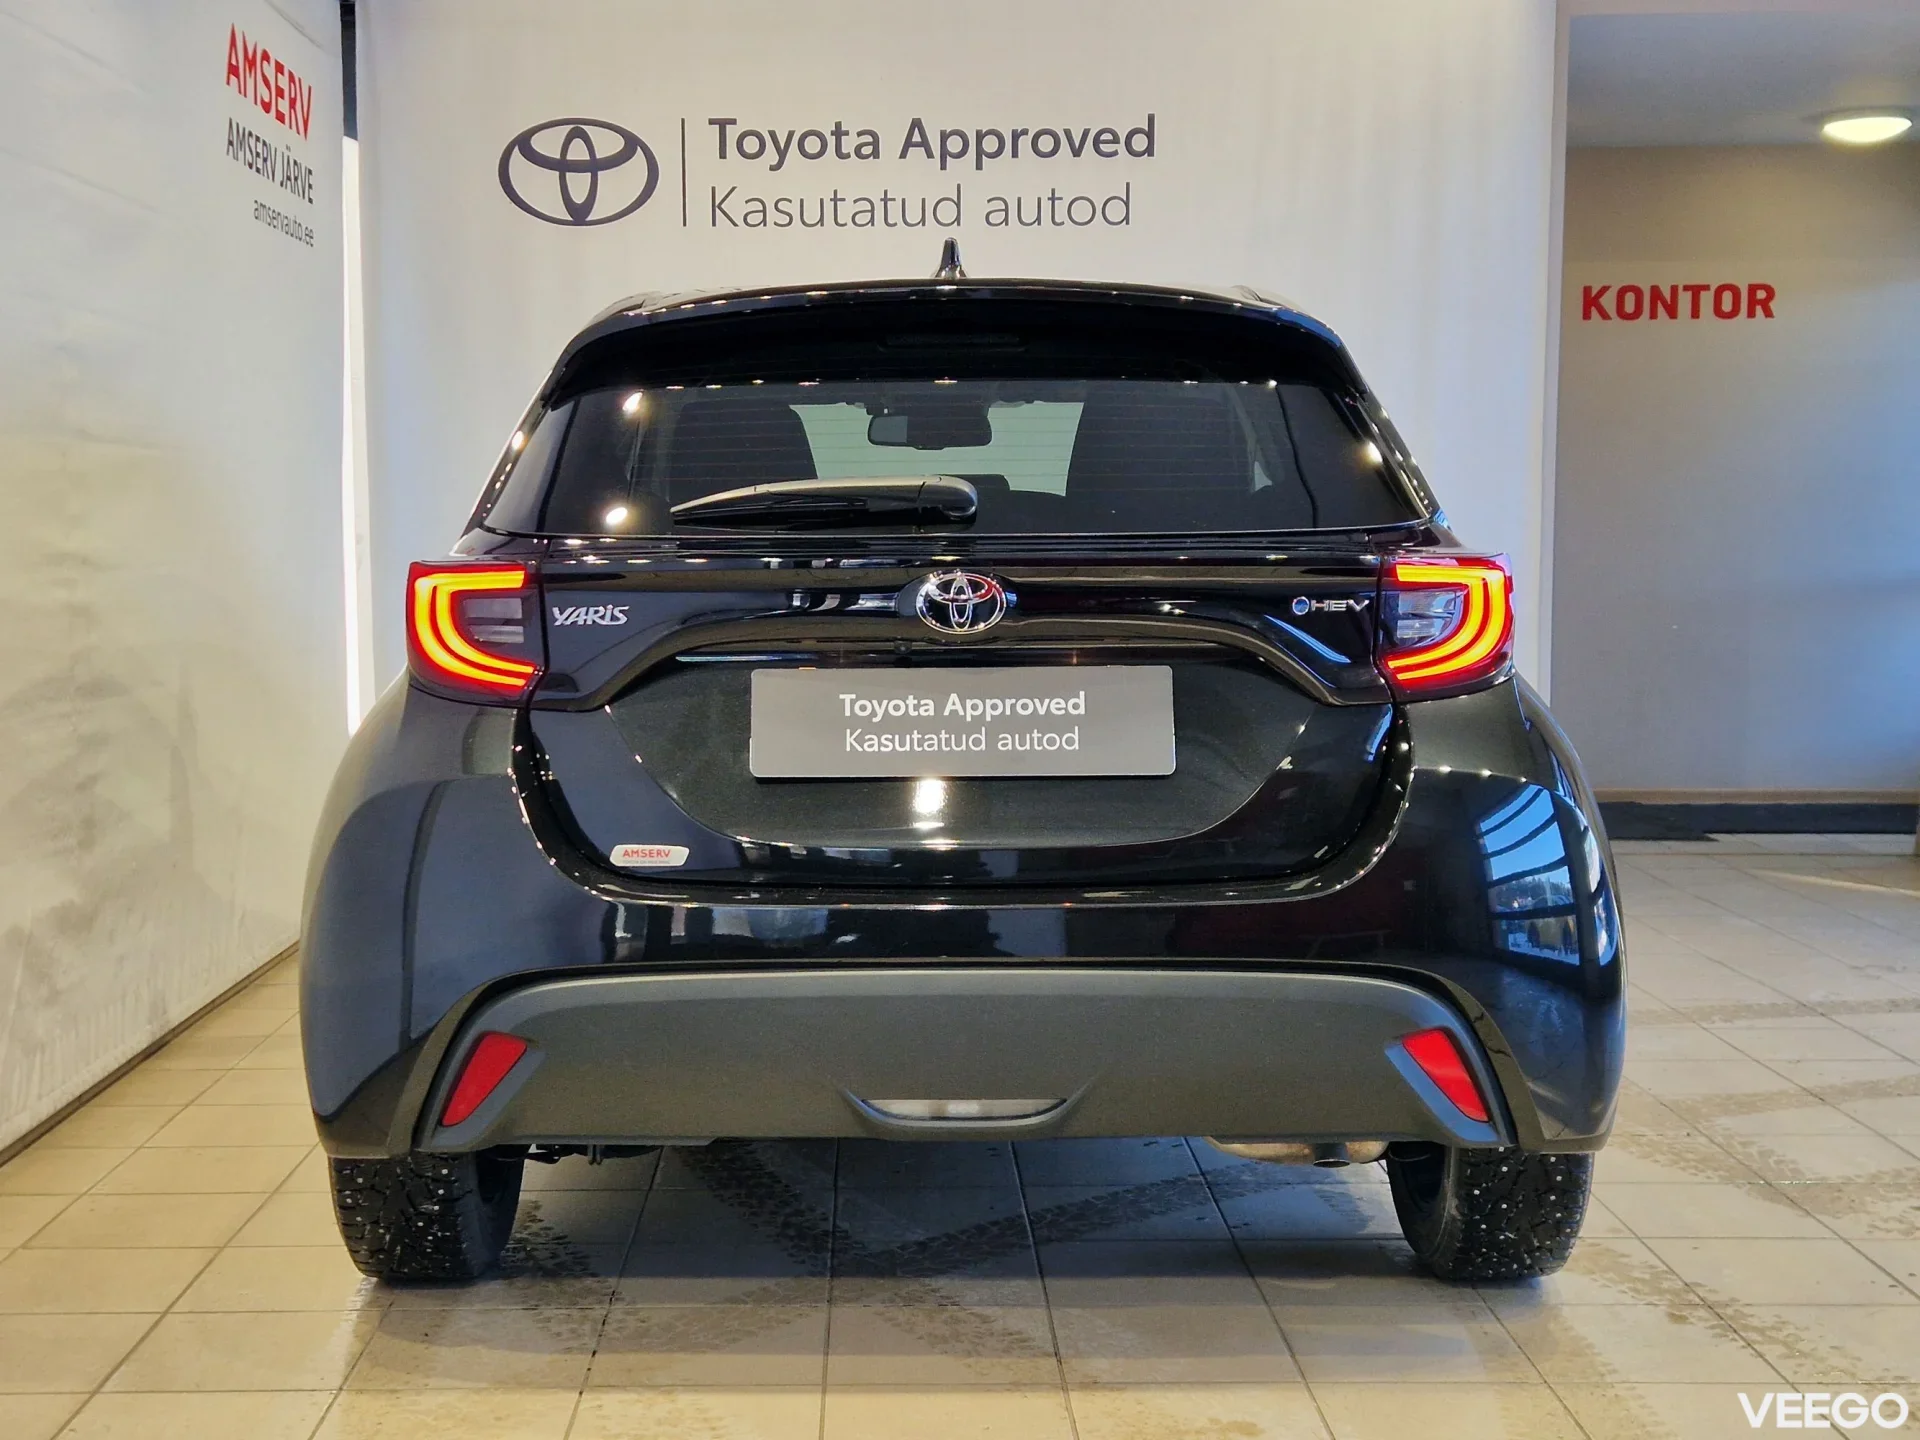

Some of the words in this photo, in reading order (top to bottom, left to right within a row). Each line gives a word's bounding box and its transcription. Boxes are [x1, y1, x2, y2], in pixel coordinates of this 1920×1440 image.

[226, 22, 311, 141] AMSERV
[226, 117, 277, 183] AMSERV
[280, 144, 313, 205] JÄRVE
[708, 117, 880, 171] Toyota
[898, 113, 1156, 171] Approved
[253, 199, 314, 248] amservauto.ee
[710, 183, 962, 228] Kasutatud
[985, 182, 1131, 227] autod
[1582, 283, 1776, 321] KONTOR
[839, 693, 935, 722] Toyota
[943, 691, 1086, 721] Approved
[845, 726, 986, 752] Kasutatud
[997, 725, 1080, 751] autod
[622, 849, 671, 858] AMSERV
